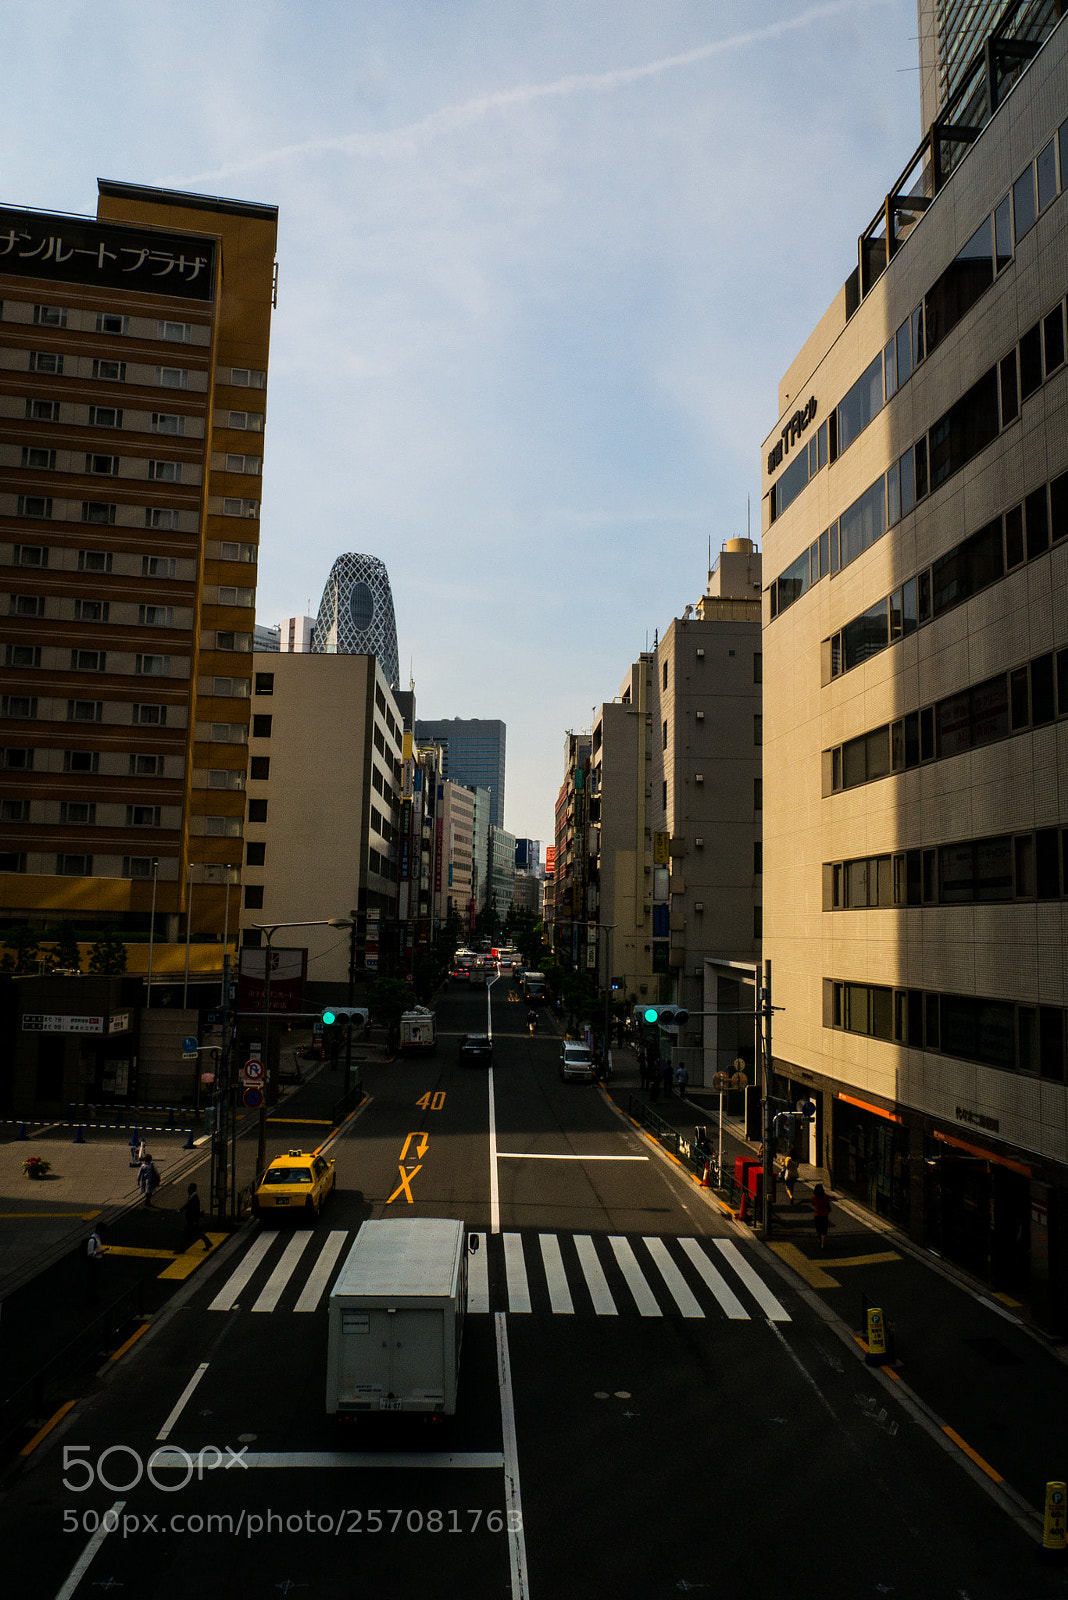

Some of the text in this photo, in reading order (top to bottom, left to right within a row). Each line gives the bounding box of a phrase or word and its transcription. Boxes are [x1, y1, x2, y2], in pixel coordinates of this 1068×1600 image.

[0, 230, 207, 281] サンルートプラザ
[416, 1091, 446, 1110] 40
